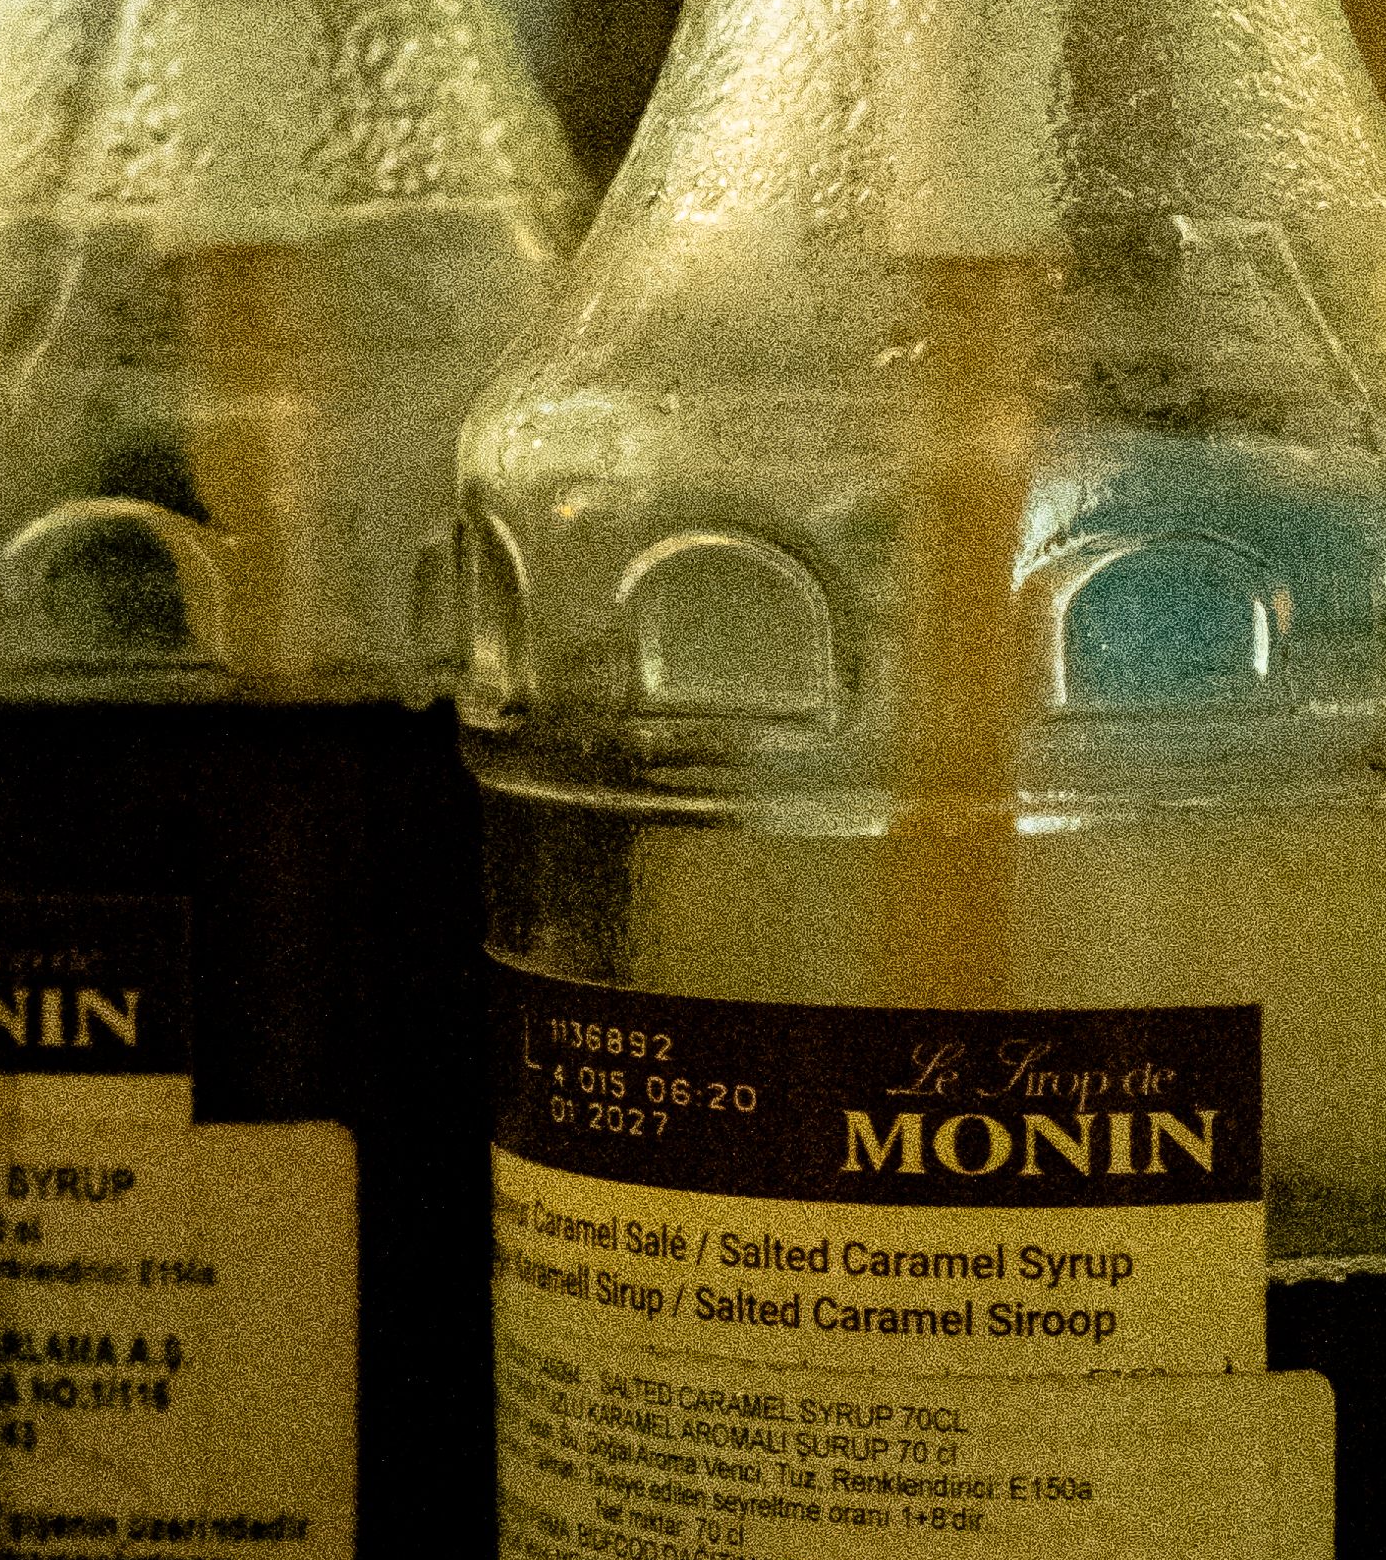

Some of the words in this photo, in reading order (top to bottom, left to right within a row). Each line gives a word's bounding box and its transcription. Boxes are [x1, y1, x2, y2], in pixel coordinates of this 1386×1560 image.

[549, 1017, 674, 1062] 1136892
[645, 1074, 758, 1114] 06:20
[885, 1041, 965, 1097] Le
[975, 1038, 1110, 1113] Sirop
[1121, 1061, 1178, 1096] de
[588, 1102, 669, 1137] 2027
[839, 1108, 1218, 1178] MONIN
[533, 1200, 617, 1251] Caramel
[624, 1220, 688, 1263] Salé
[719, 1233, 829, 1274] Salted
[842, 1240, 1006, 1280] Caramel
[1019, 1244, 1135, 1289] Syrup
[595, 1270, 663, 1321] Sirup
[694, 1286, 800, 1329] Salted
[813, 1296, 973, 1337] Caramel
[987, 1300, 1118, 1345] Siroop
[677, 1382, 794, 1422] CARAMEL
[799, 1399, 894, 1430] SYRUP
[900, 1404, 969, 1434] 70CL
[680, 1418, 787, 1454] AROMALI
[793, 1430, 888, 1463] ŞURUP
[898, 1440, 928, 1464] 70
[936, 1443, 958, 1467] cl
[713, 1488, 820, 1525] seyreltme
[1009, 1475, 1094, 1503] E150a
[695, 1516, 720, 1543] 70
